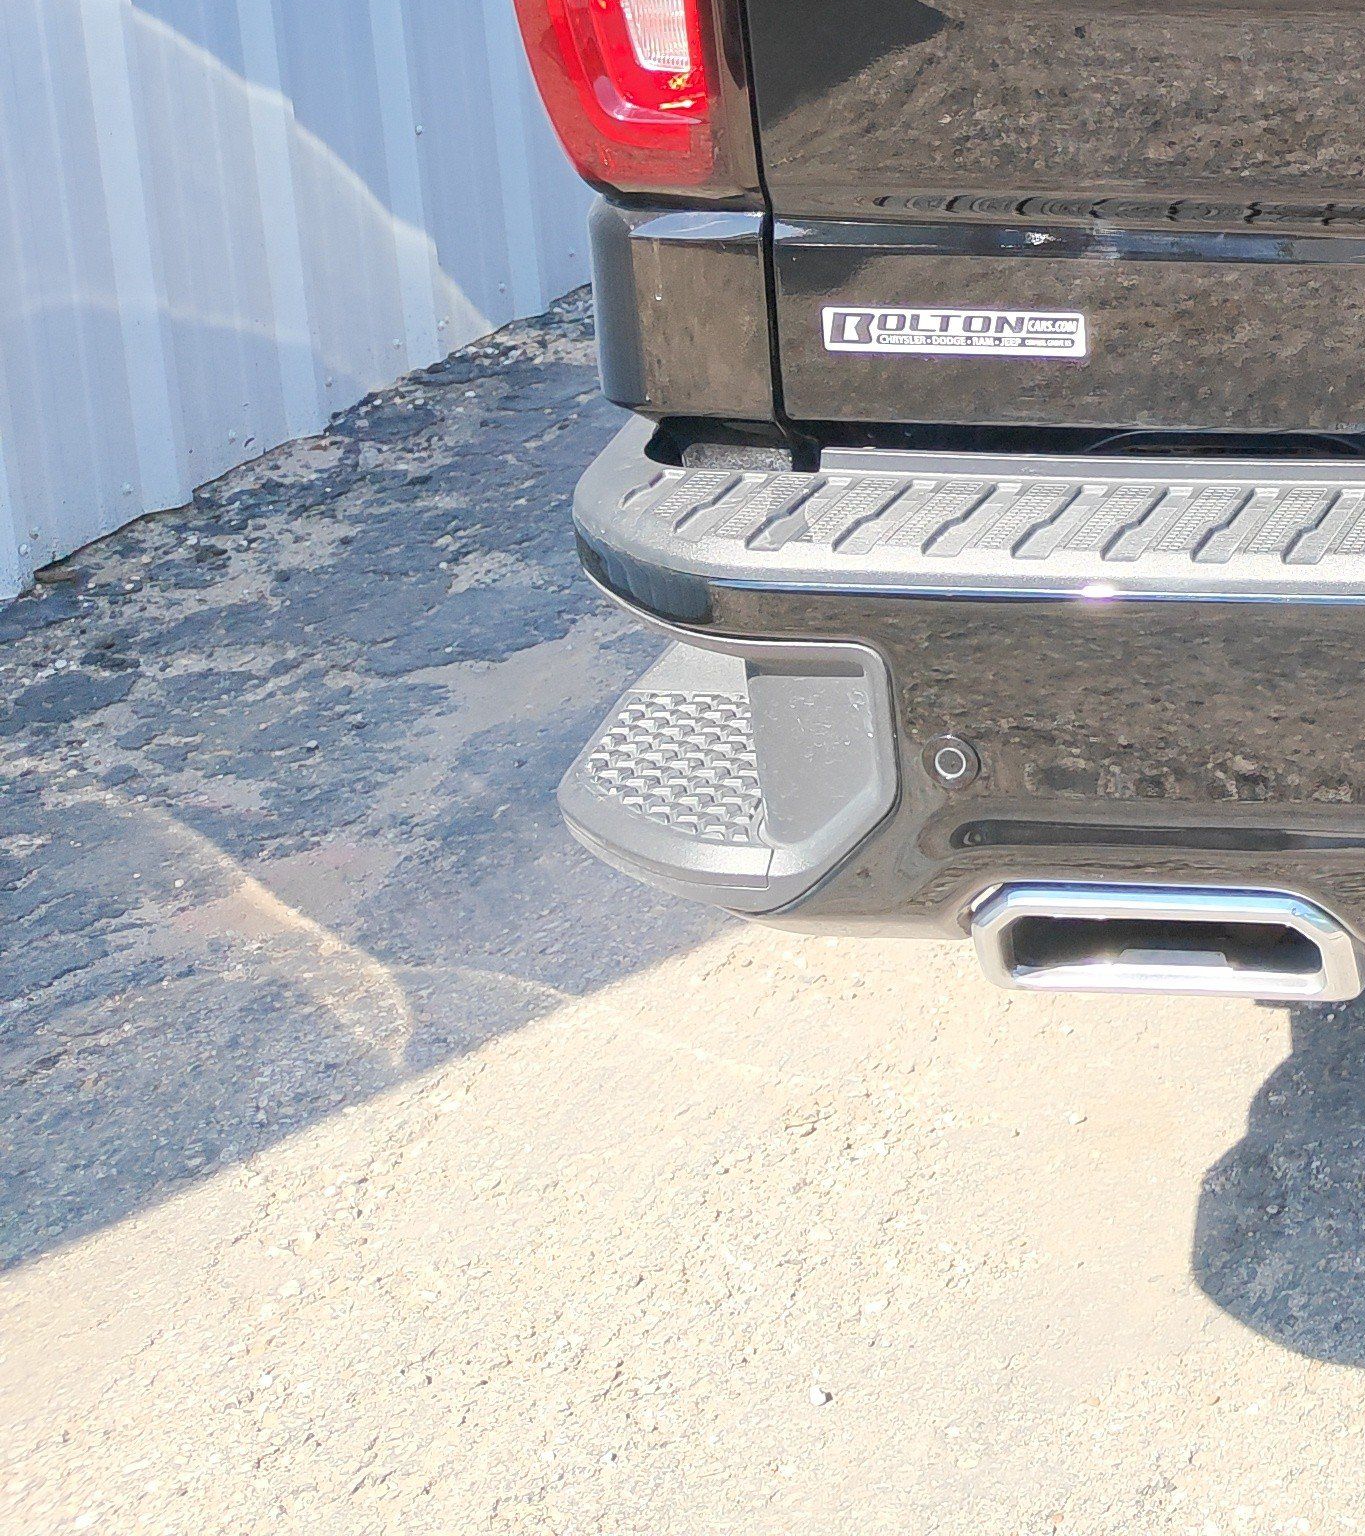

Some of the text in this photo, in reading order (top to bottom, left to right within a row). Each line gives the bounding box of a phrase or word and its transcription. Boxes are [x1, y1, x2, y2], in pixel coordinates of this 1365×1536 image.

[829, 311, 1025, 344] BOLTON
[879, 335, 927, 346] CHRYSLER
[931, 336, 966, 346] DODGE
[971, 336, 995, 347] RAM
[999, 337, 1022, 347] JEEP
